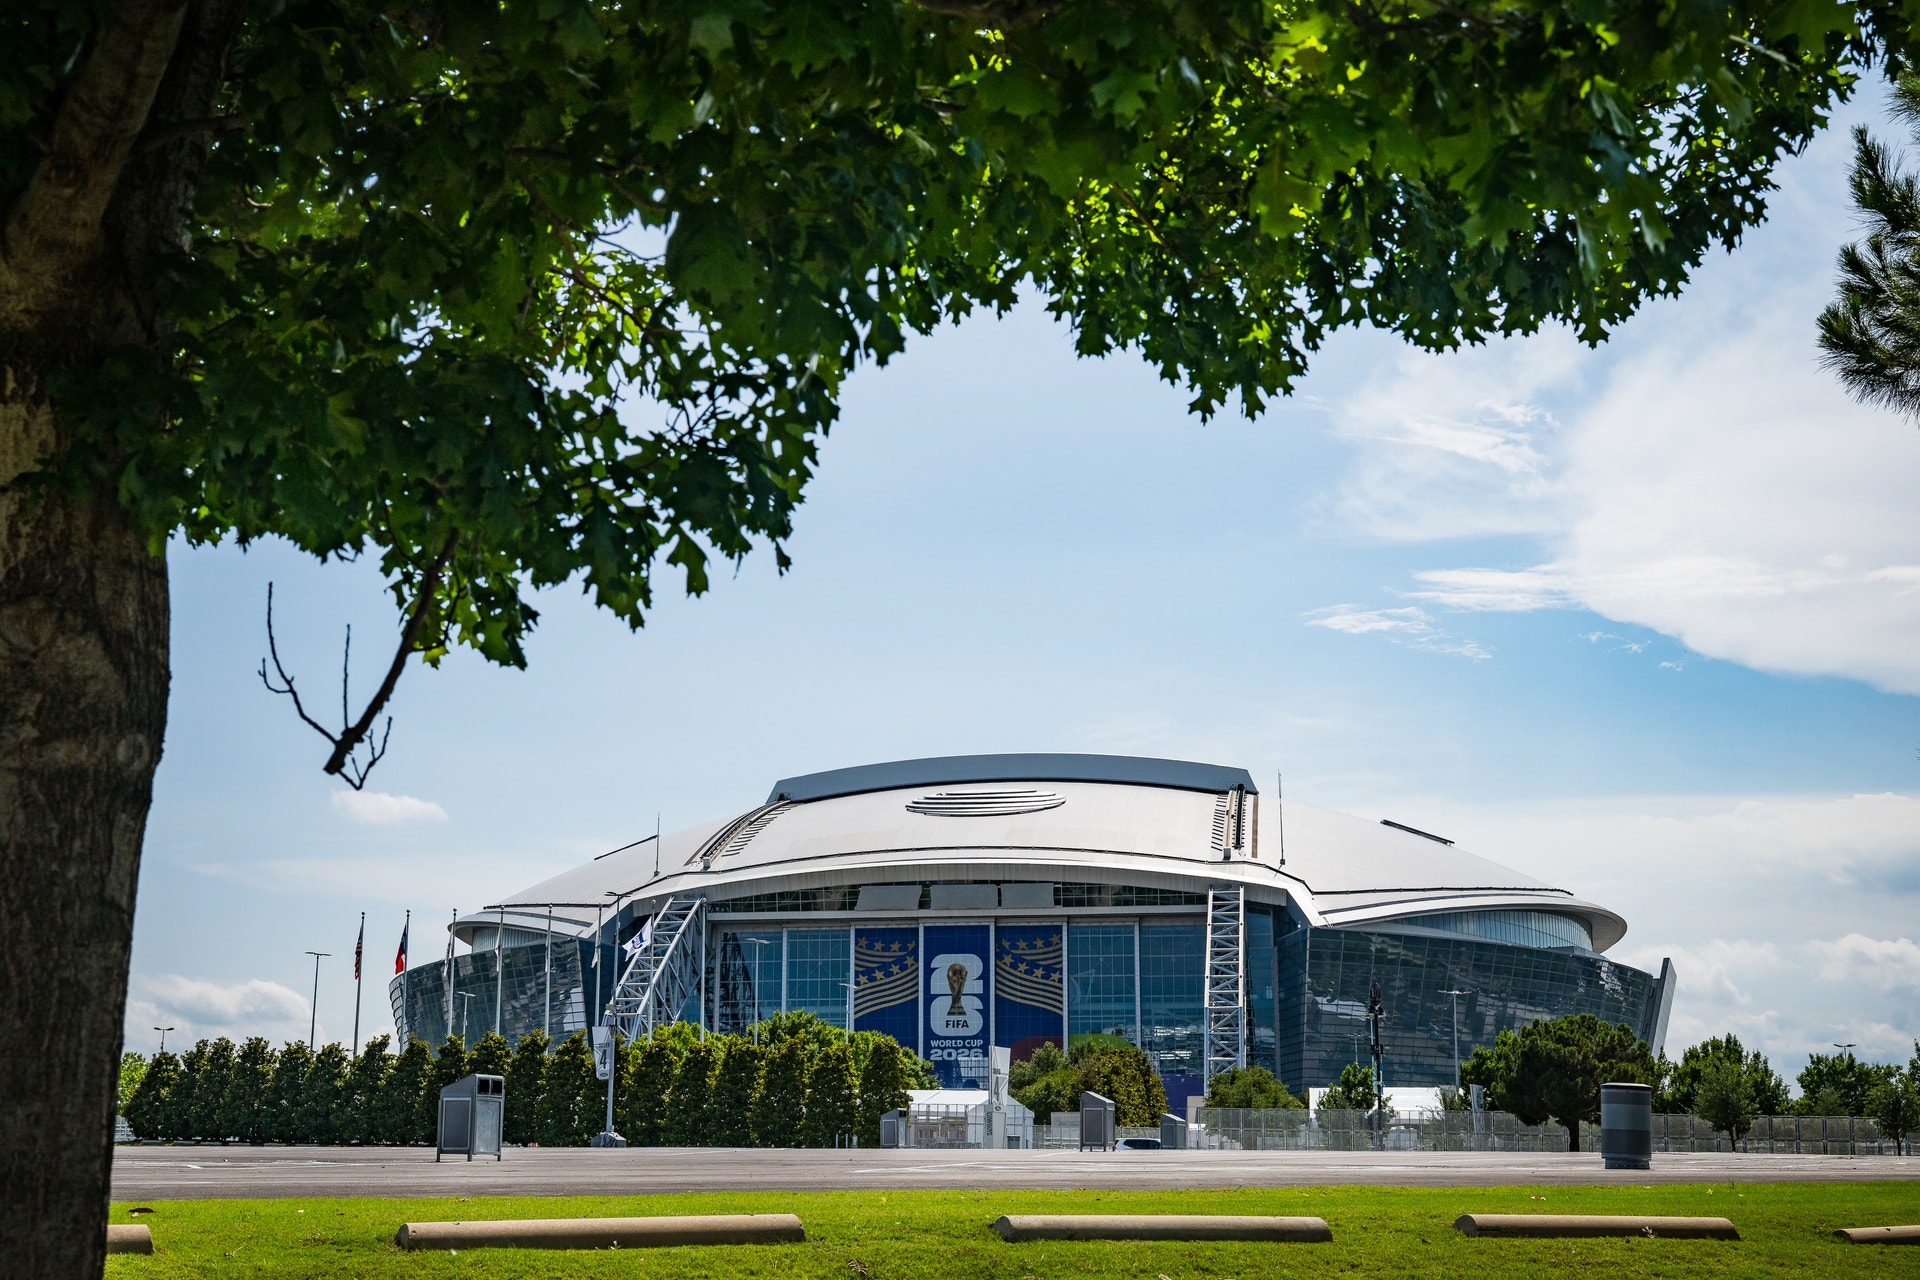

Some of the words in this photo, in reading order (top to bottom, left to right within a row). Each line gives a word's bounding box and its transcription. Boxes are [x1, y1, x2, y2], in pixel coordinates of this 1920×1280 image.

[945, 1020, 969, 1029] FIFA
[930, 1039, 963, 1048] WORLD
[964, 1039, 984, 1048] CUP
[600, 1049, 607, 1069] 4
[929, 1048, 984, 1061] 2026
[993, 1076, 1000, 1102] 4
